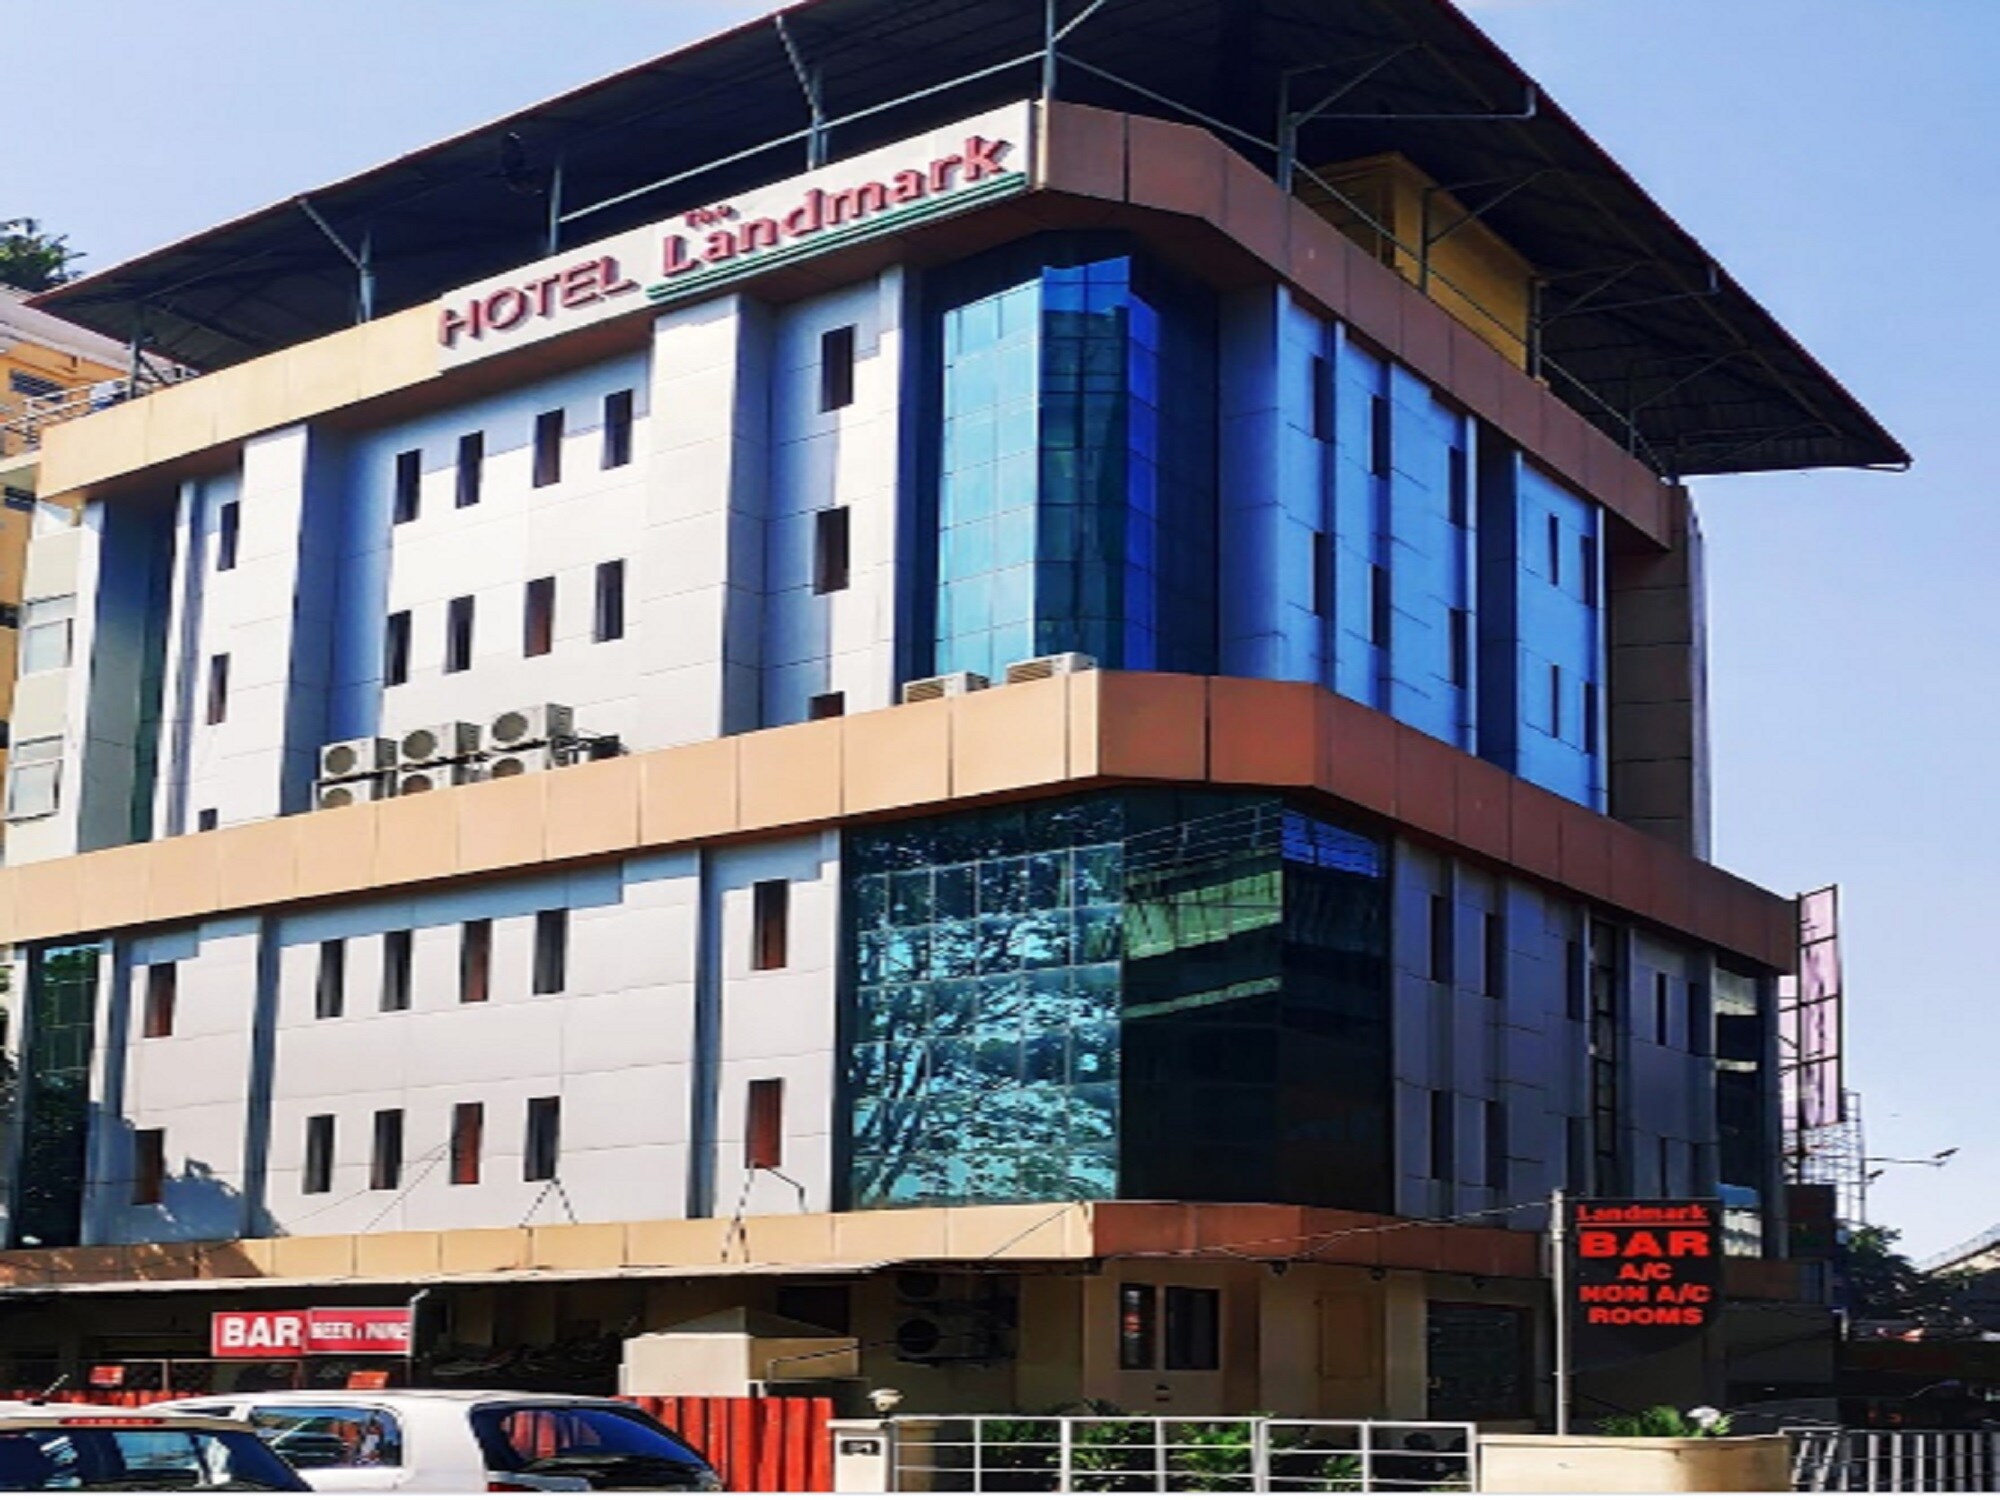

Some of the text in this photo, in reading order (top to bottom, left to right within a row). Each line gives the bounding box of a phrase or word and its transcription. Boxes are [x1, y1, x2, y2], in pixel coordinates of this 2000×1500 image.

[438, 135, 1012, 348] HOTEL Landmark
[1576, 1204, 1708, 1221] Landmark
[1579, 1231, 1710, 1257] BAR
[1617, 1263, 1673, 1281] A/C
[1579, 1283, 1711, 1303] NON A/C
[1588, 1307, 1703, 1325] ROOMS
[221, 1316, 303, 1347] BAR
